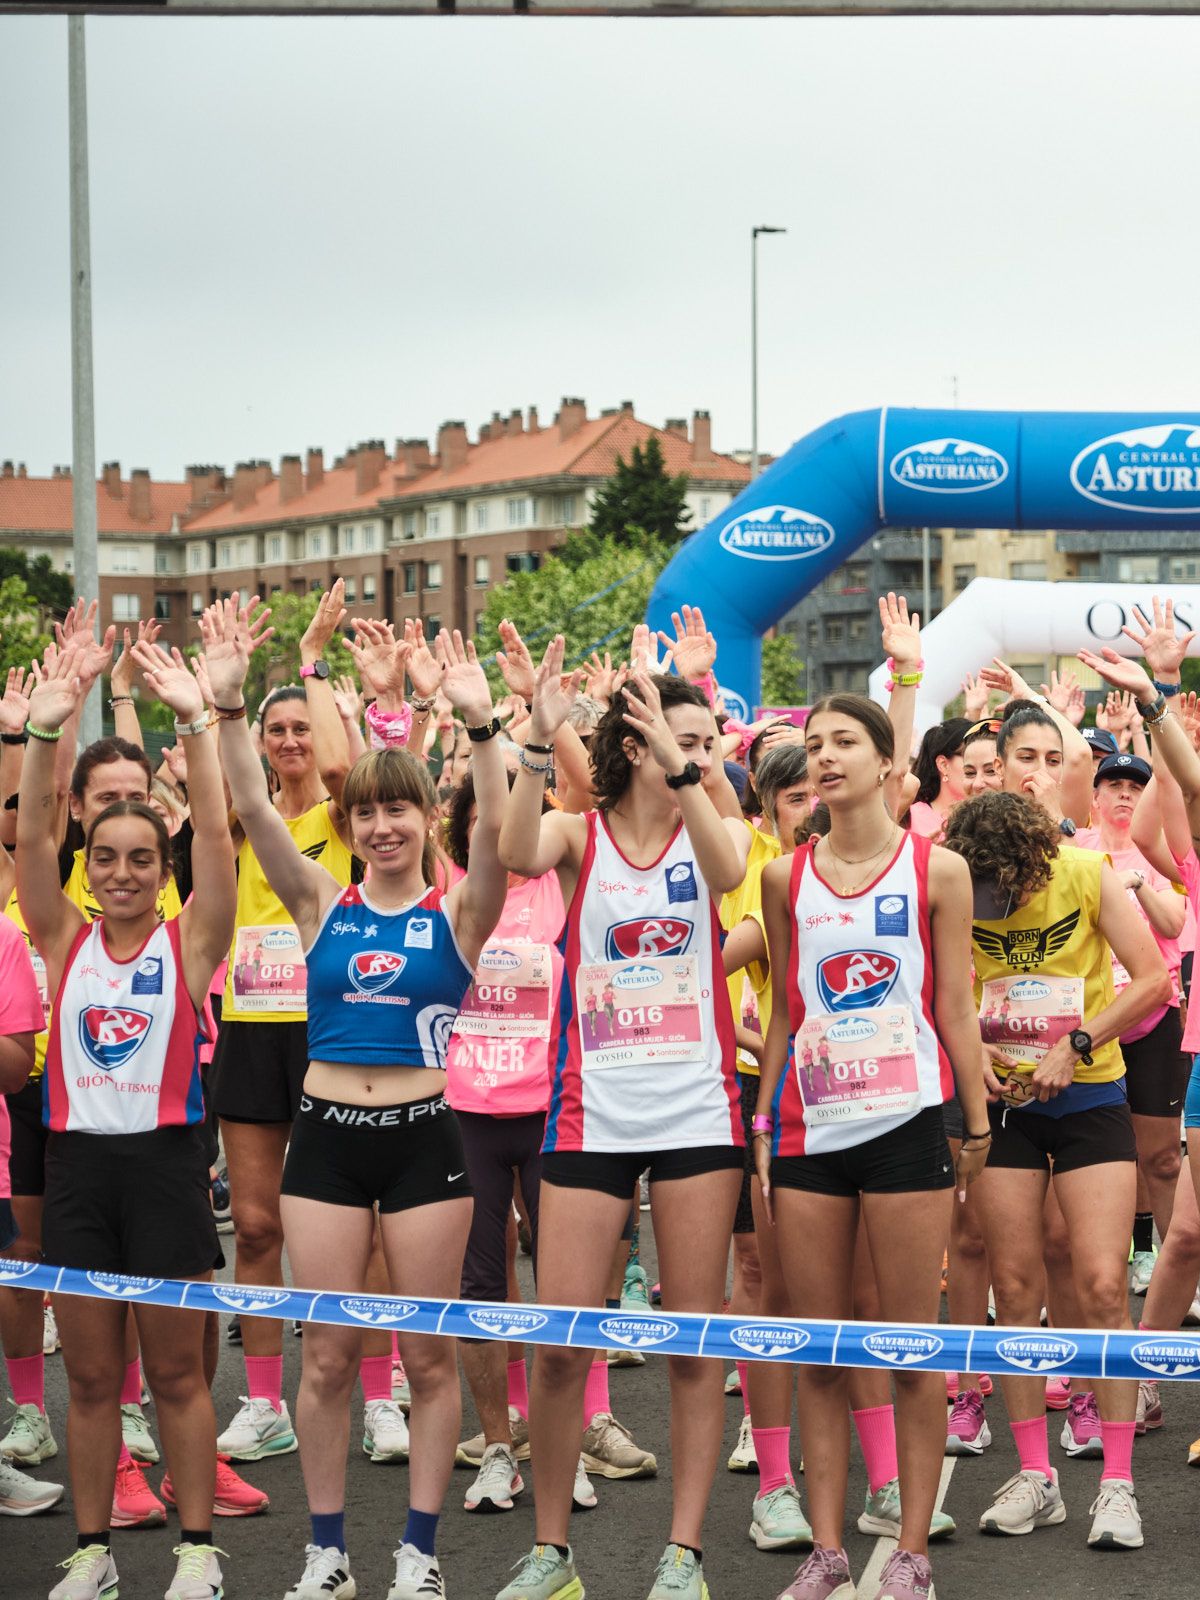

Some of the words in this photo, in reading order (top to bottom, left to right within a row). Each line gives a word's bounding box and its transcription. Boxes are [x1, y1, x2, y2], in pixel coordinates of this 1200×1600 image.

[1119, 451, 1187, 463] CENTRAL
[900, 455, 1000, 480] ASTURIANA
[728, 524, 826, 547] ASTURIANA
[331, 922, 360, 935] gijón
[1010, 931, 1038, 943] BORN
[480, 956, 519, 966] ASTURIANA
[1011, 951, 1040, 963] RUN
[260, 965, 294, 979] 016
[615, 974, 659, 986] ASTURIANA
[478, 985, 517, 1001] 016
[1011, 989, 1048, 998] ASTURIANA
[617, 1006, 663, 1026] 016
[456, 1021, 487, 1029] OYSHO
[634, 1027, 650, 1036] 983
[1008, 1017, 1049, 1032] 016
[830, 1027, 875, 1038] ASTURIANA
[599, 1040, 625, 1049] CARRERA
[596, 1051, 632, 1064] OYSHO
[834, 1059, 879, 1081] 016
[114, 1082, 160, 1094] LETISMO
[850, 1081, 866, 1091] 982
[323, 1106, 401, 1126] NIKE
[817, 1106, 851, 1118] OYSHO
[873, 1100, 909, 1111] Santander
[348, 1300, 412, 1314] ASTURIANA
[476, 1311, 541, 1326] ASTURIANA
[607, 1321, 672, 1336] ASTURIANA
[737, 1330, 803, 1344] ASTURIANA
[870, 1337, 937, 1351] ASTURIANA
[1004, 1342, 1071, 1357] ASTURIANA
